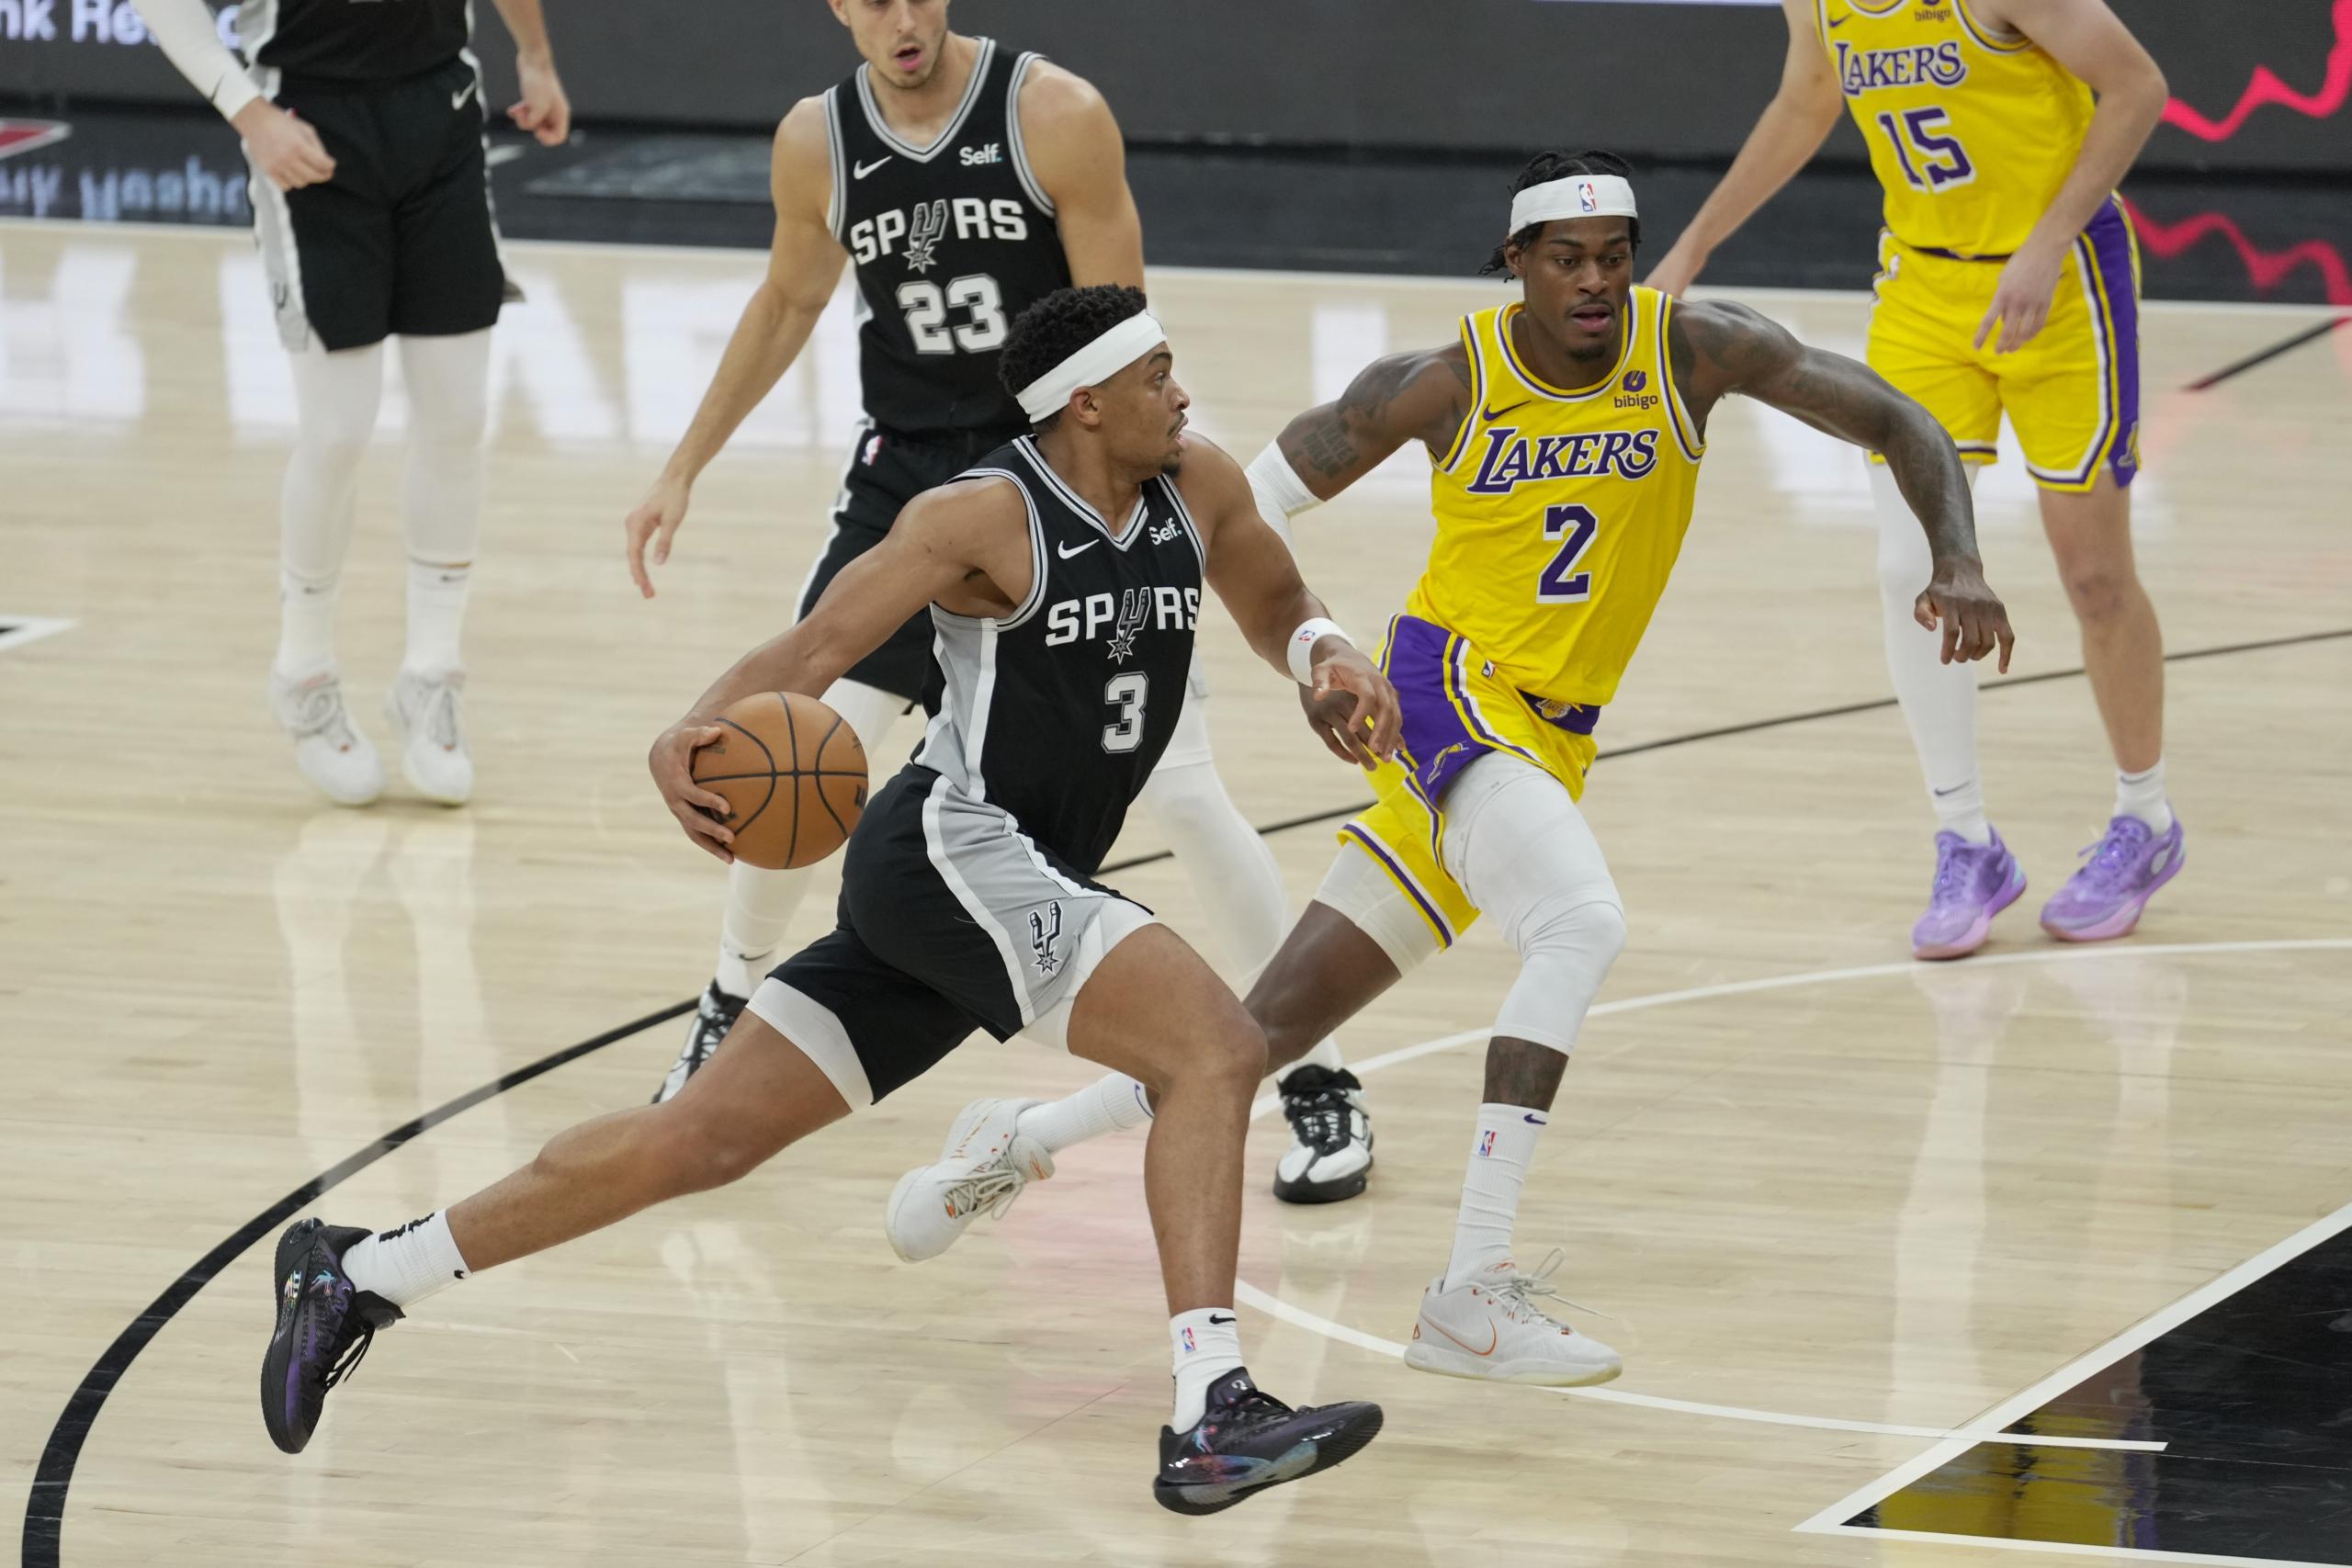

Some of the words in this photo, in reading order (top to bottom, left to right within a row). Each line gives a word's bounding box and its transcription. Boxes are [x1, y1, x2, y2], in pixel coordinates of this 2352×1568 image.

[1915, 8, 1951, 22] bibigo
[1834, 40, 1967, 97] LAKERS
[1876, 106, 1977, 195] 15
[850, 197, 1028, 273] SPURS
[896, 273, 1009, 355] 23
[1613, 393, 1658, 410] bibigo
[1465, 426, 1660, 494] LAKERS
[1535, 503, 1600, 604] 2
[1101, 671, 1148, 753] 3
